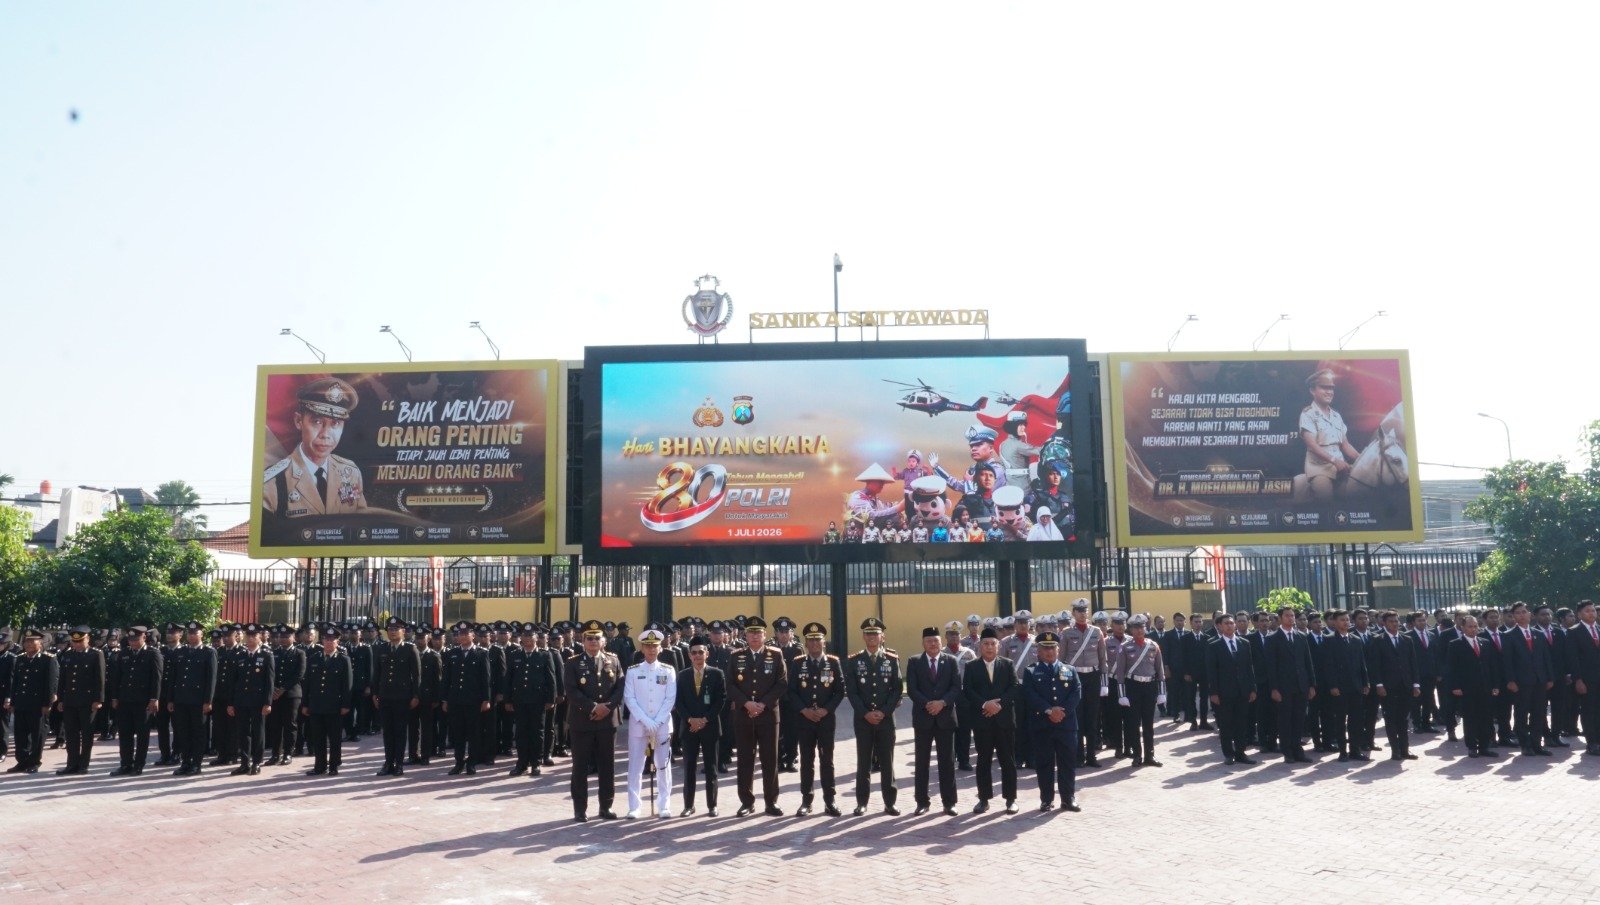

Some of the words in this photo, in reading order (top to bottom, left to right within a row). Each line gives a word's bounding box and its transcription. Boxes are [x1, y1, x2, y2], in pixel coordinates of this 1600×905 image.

[750, 312, 839, 328] SANIKA
[1168, 394, 1195, 404] KALAU
[1196, 394, 1217, 404] KITA
[440, 395, 515, 423] MENJADI
[1151, 408, 1186, 419] SEJARAH
[1189, 408, 1214, 418] TIDAK
[1215, 407, 1235, 418] BISA
[1236, 406, 1281, 417] DIBOHONGI
[1163, 421, 1195, 432] KARENA
[1196, 421, 1222, 431] NANTI
[1224, 421, 1246, 431] YANG
[1247, 420, 1270, 430] AKAN
[377, 425, 441, 447] ORANG
[445, 424, 523, 446] PENTING
[1142, 436, 1201, 447] MEMBUKTIKAN
[1202, 435, 1239, 446] SEJARAH
[1240, 435, 1255, 445] ITU
[396, 450, 423, 461] TETAPI
[424, 449, 447, 461] JAUH
[449, 448, 471, 460] LEBIH
[473, 446, 510, 460] PENTING
[622, 437, 655, 458] Hari
[658, 434, 831, 456] BHAYANGKARA
[377, 464, 431, 481] MENJADI
[435, 463, 480, 480] ORANG
[648, 461, 727, 516] 80
[1178, 481, 1189, 495] H.
[1190, 480, 1260, 495] MOEHAMMAD
[1261, 479, 1292, 494] JASIN
[724, 487, 792, 507] POLRI
[727, 528, 732, 537] 1
[734, 528, 756, 537] JULI
[756, 528, 783, 537] 2026
